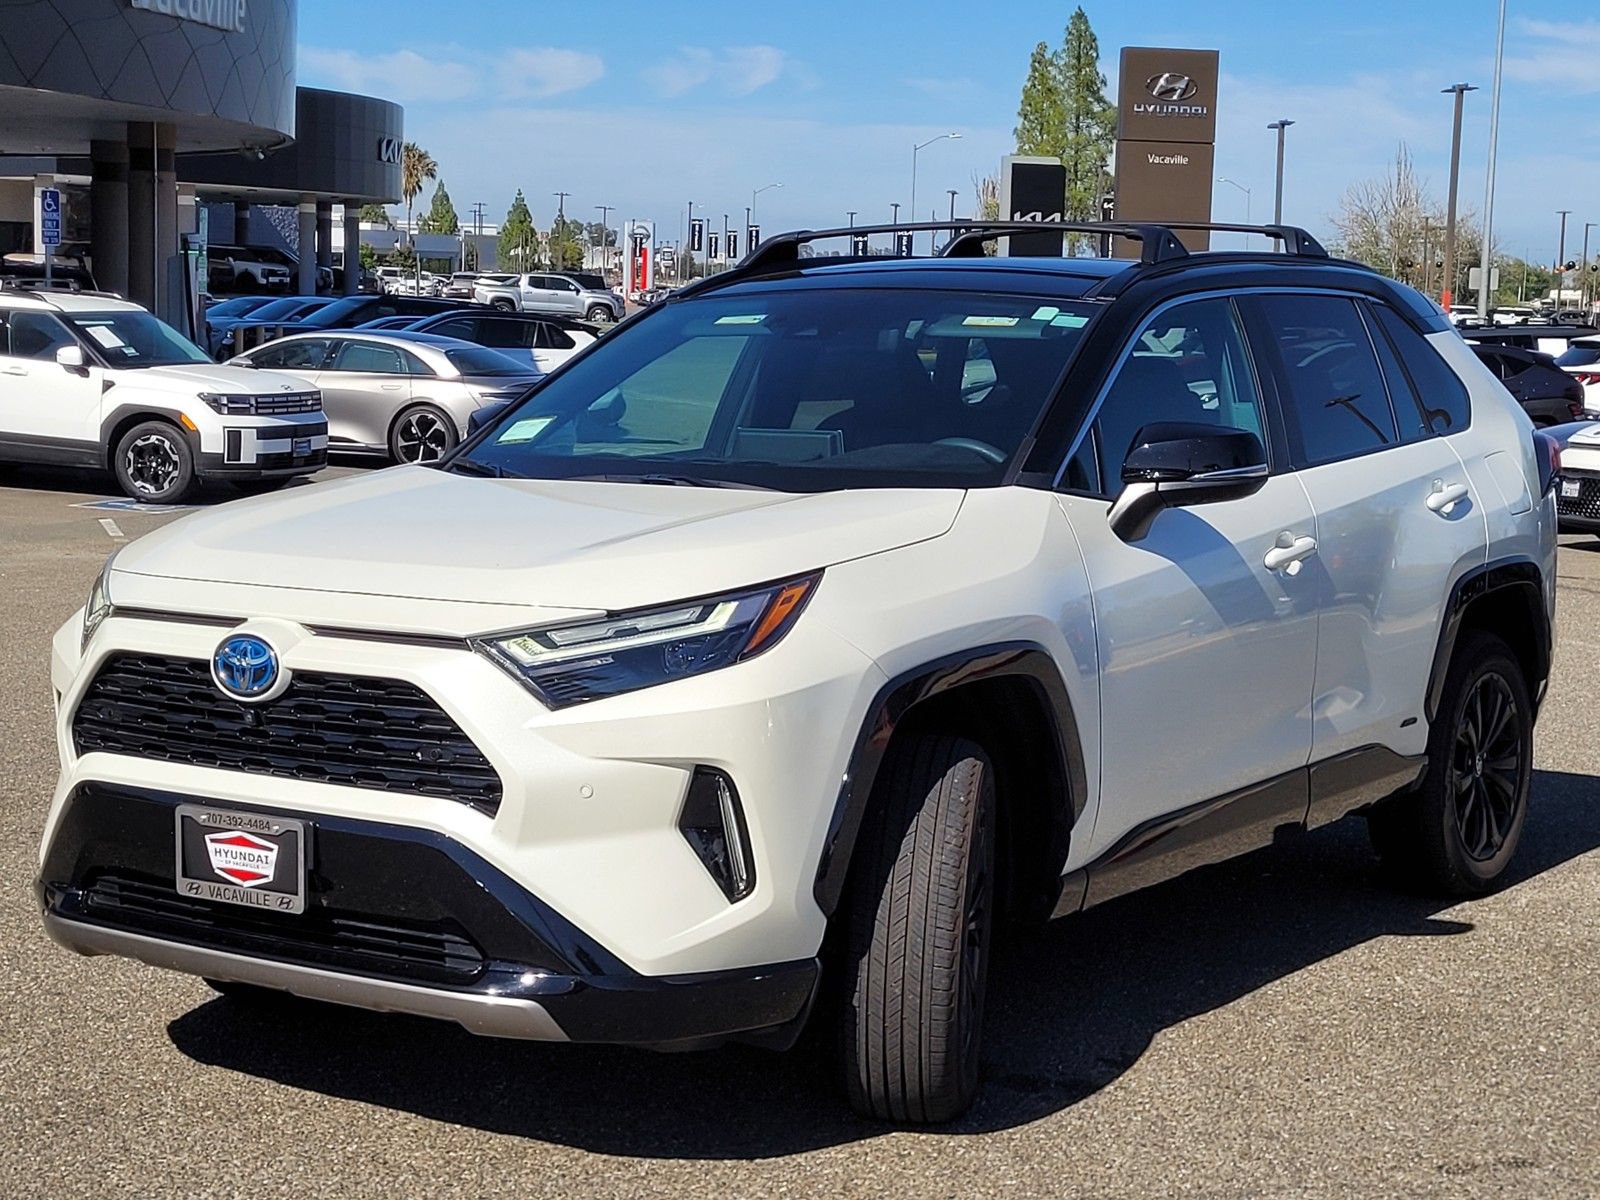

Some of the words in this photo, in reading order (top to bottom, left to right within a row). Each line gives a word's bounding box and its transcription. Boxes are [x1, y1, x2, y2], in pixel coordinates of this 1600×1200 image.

[133, 0, 245, 33] acaville
[1147, 153, 1189, 165] Vacaville
[1013, 211, 1062, 222] KIA
[206, 812, 271, 831] 707-392-4484
[214, 847, 269, 865] HYUNDAI
[208, 885, 271, 906] VACAVILLE
